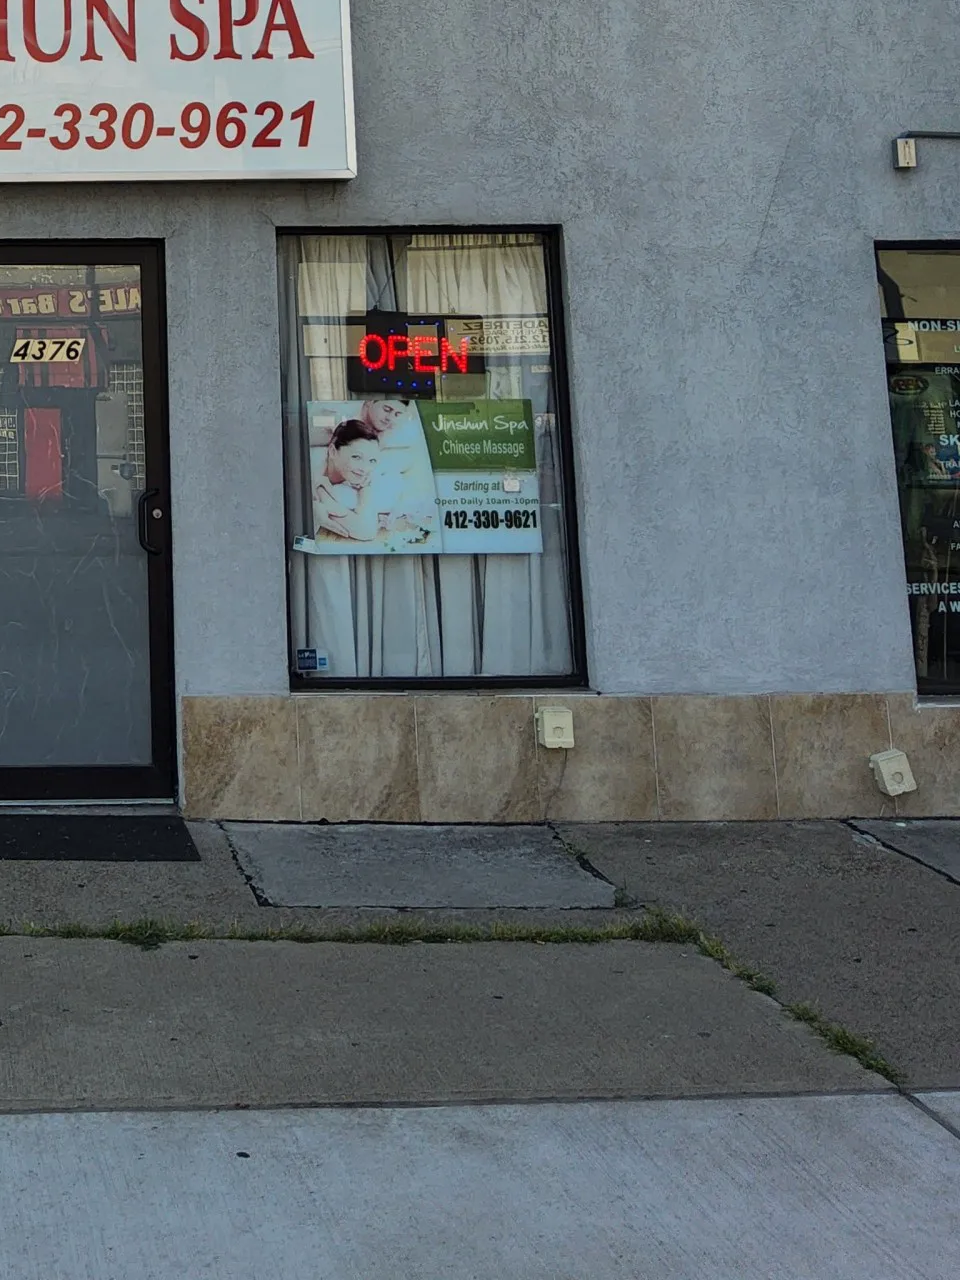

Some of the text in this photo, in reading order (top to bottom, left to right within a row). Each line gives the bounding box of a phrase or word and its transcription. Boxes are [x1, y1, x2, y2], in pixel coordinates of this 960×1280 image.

[13, 340, 81, 360] 4376
[360, 333, 468, 373] OPEN
[432, 414, 529, 435] Jinshun Spa
[442, 440, 525, 457] Chinese Massage
[454, 480, 500, 493] Starting at
[434, 497, 539, 506] Open Daily 10am-10pm
[444, 510, 538, 529] 412-330-9621
